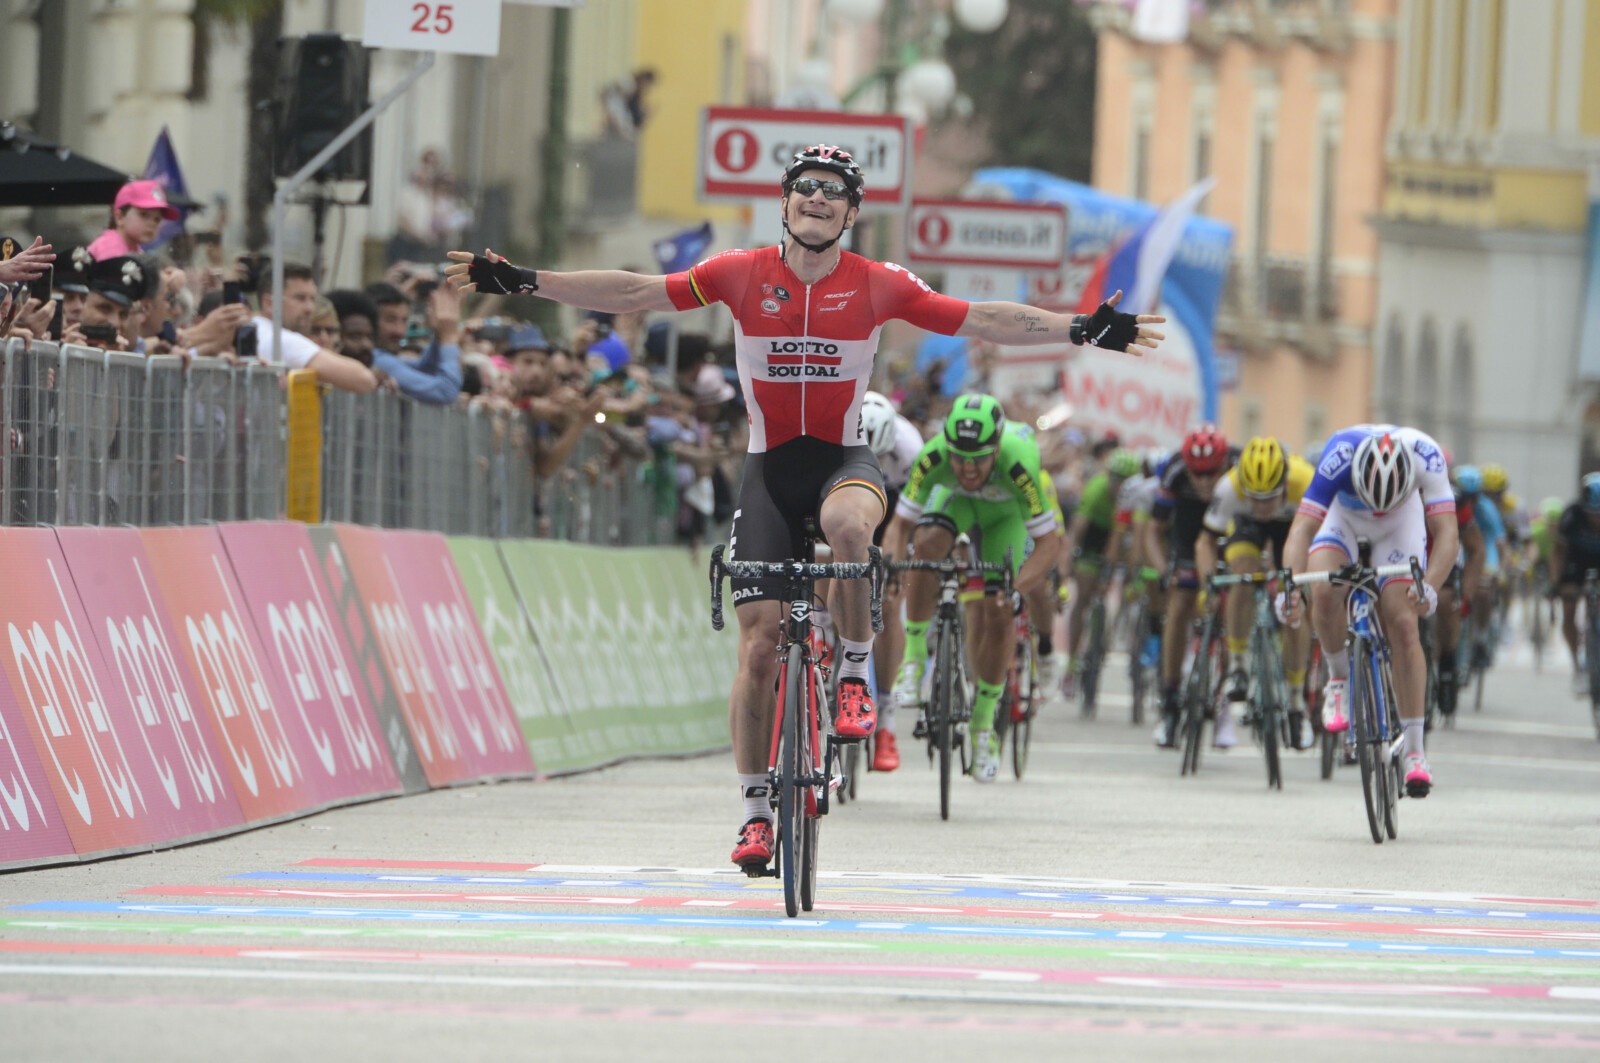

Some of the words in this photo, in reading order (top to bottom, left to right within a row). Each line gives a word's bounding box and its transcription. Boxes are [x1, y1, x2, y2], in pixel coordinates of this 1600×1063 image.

[411, 3, 454, 34] 25
[771, 341, 838, 355] LOTTO
[768, 365, 839, 378] SOUDAL
[732, 586, 763, 601] DAL
